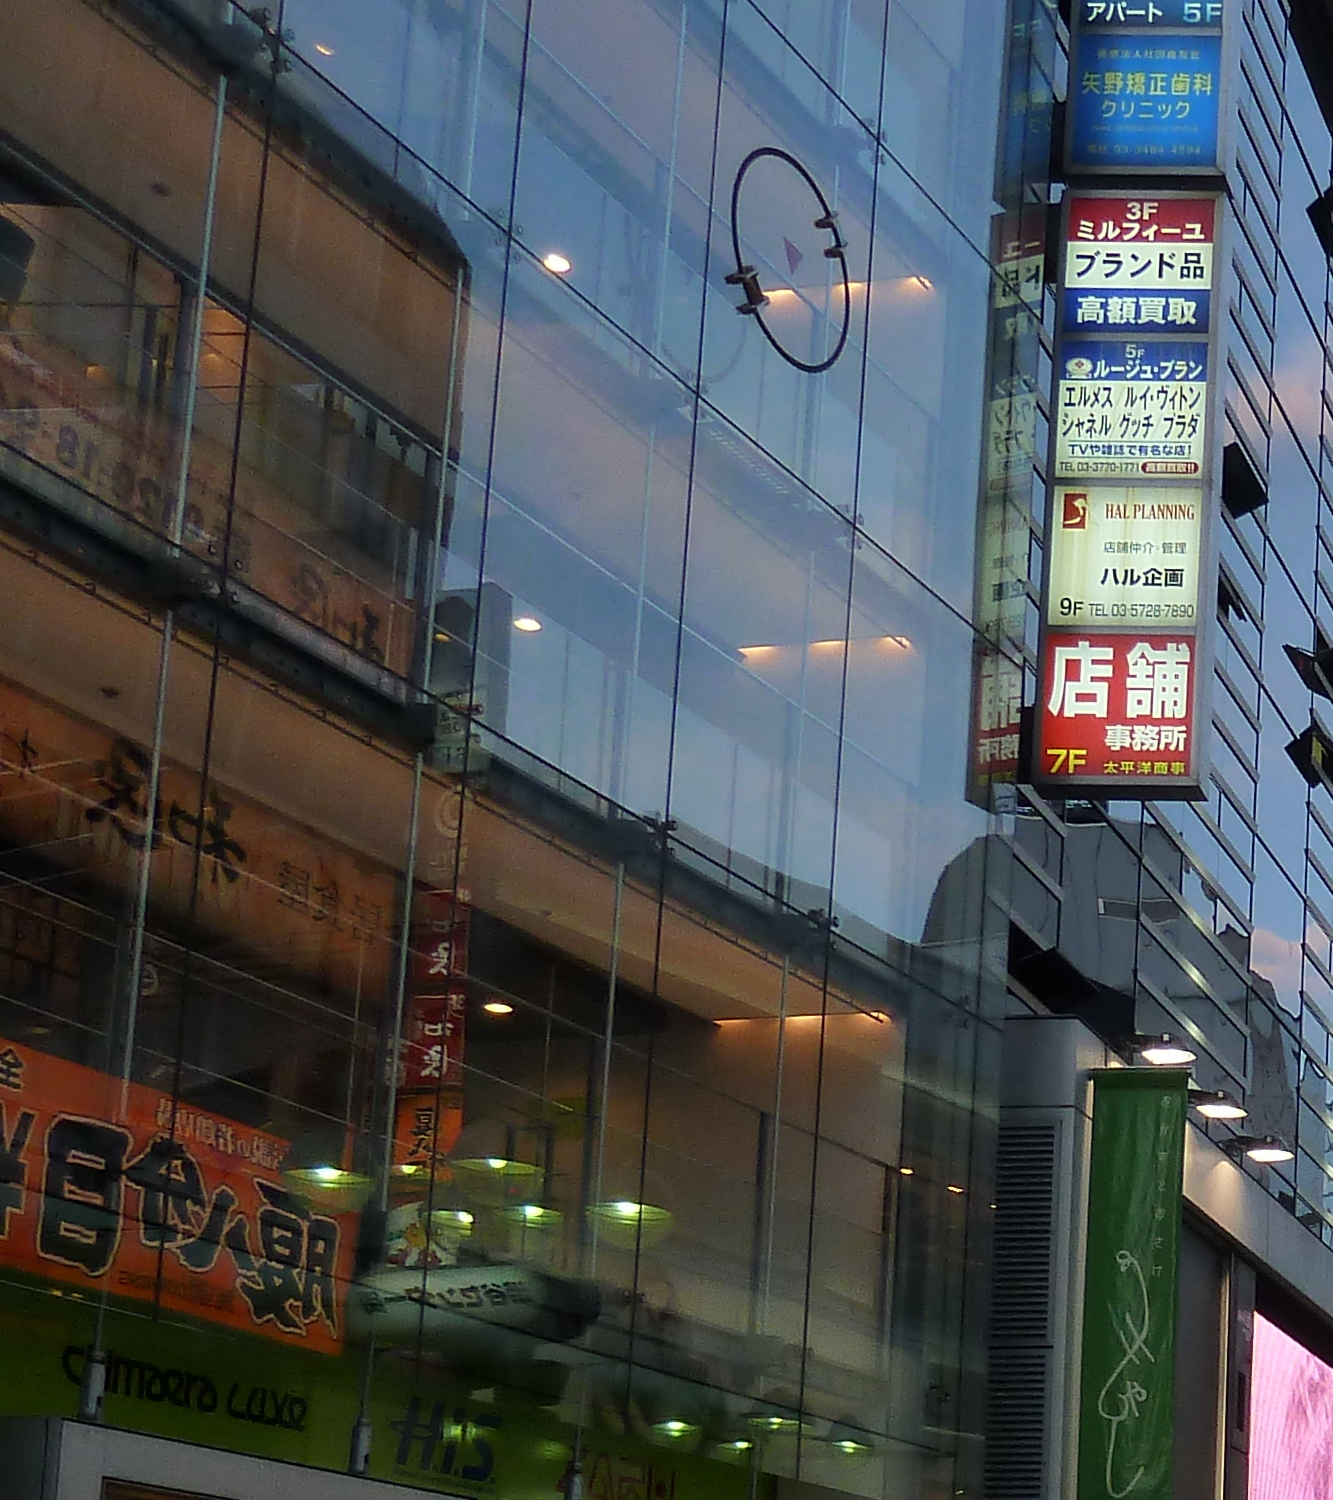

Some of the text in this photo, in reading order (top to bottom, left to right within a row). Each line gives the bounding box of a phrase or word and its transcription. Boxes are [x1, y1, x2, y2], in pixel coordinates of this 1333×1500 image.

[1086, 2, 1222, 23] アパート 5F
[1082, 71, 1212, 96] 矢野矯正歯科
[1102, 101, 1190, 119] クリニック
[1126, 202, 1159, 220] 3F
[1077, 221, 1205, 241] ミルフィーユ
[1075, 250, 1204, 280] ブランド品
[1077, 296, 1197, 325] 高額買取
[1125, 344, 1145, 358] 5F
[1064, 386, 1113, 409] エルメス
[1062, 413, 1111, 438] シャネル
[1119, 413, 1154, 439] グッチ
[1105, 503, 1195, 520] HAL PLANNING
[1100, 568, 1184, 587] ハル企画
[1060, 597, 1084, 616] 9F
[1089, 603, 1108, 617] TEL
[1048, 641, 1191, 718] 店舗
[1105, 724, 1187, 751] 事務所
[1047, 749, 1087, 774] 7F
[1103, 761, 1185, 774] 太平洋商事
